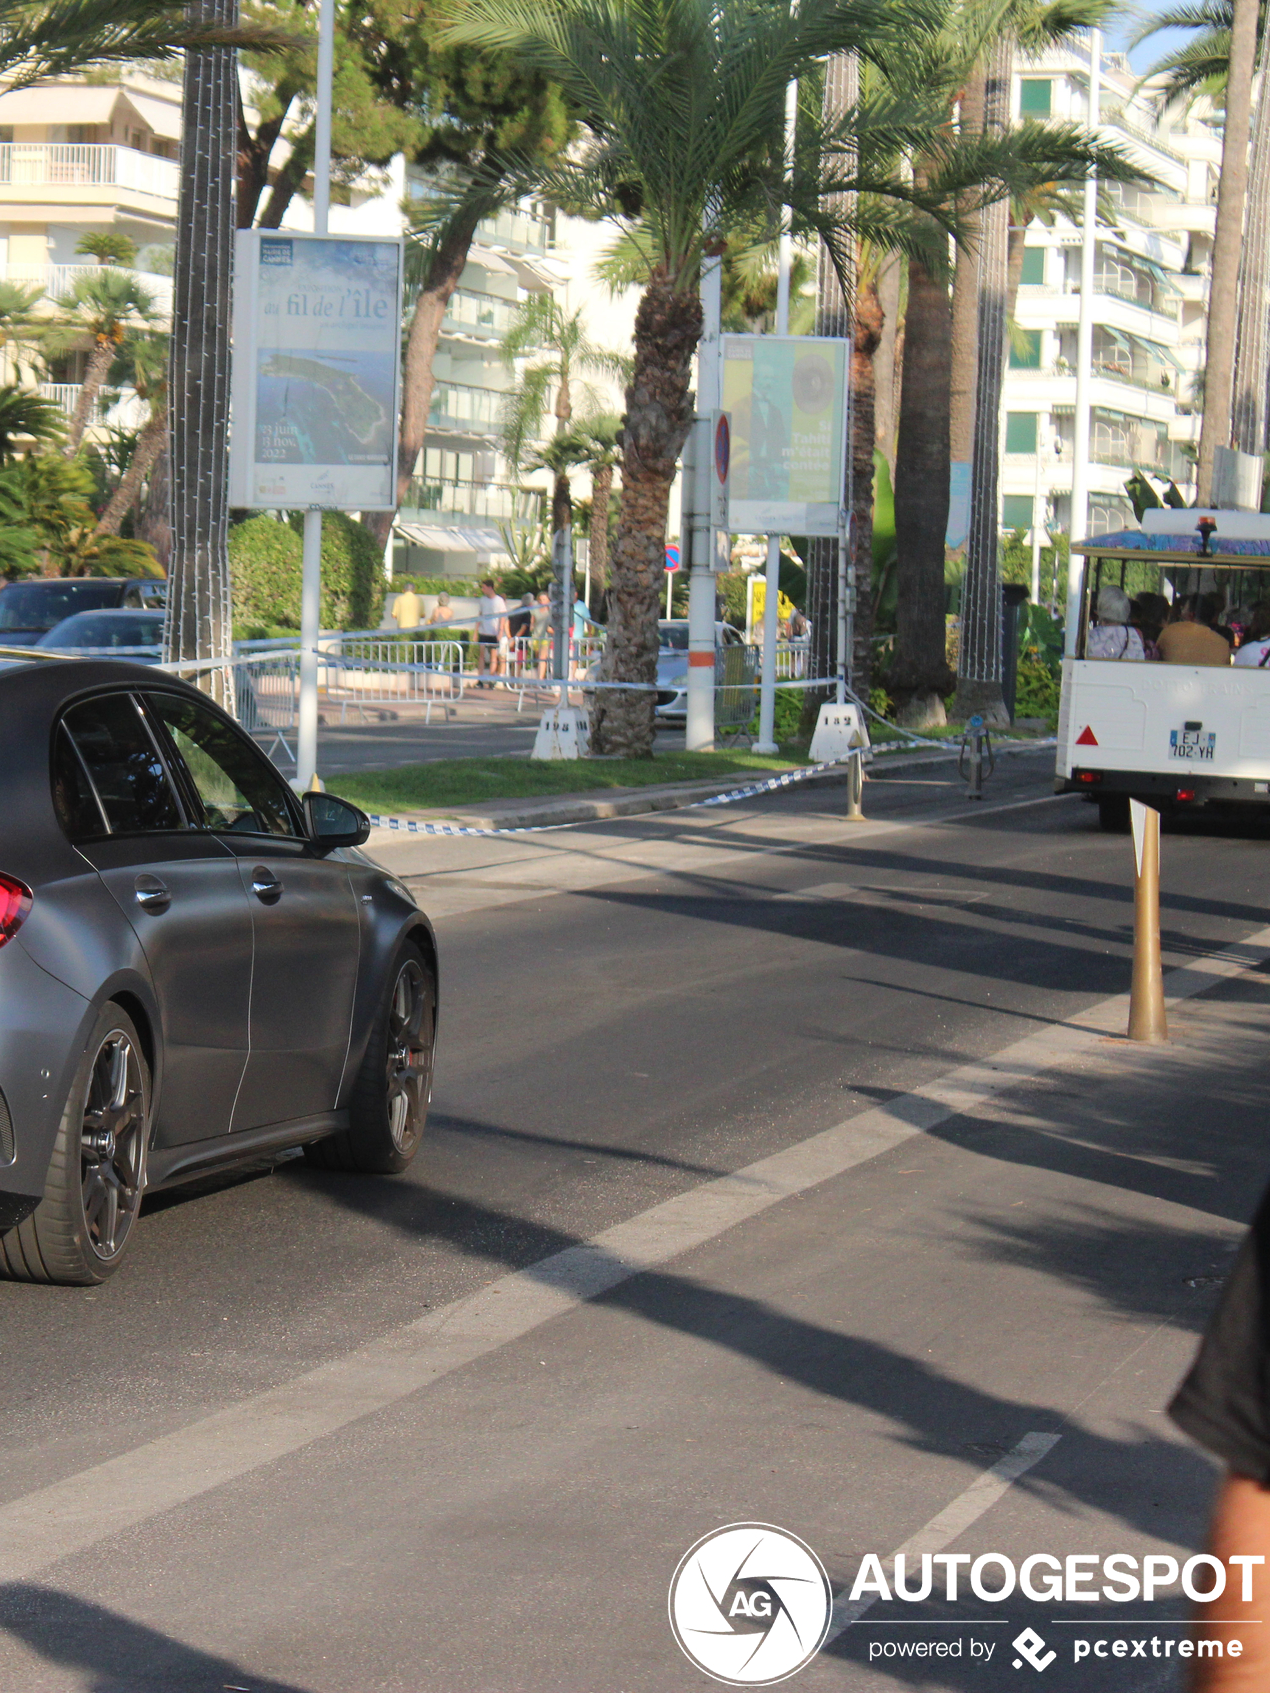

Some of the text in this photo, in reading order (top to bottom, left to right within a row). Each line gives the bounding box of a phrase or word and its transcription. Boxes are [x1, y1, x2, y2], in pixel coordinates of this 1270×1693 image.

[264, 302, 280, 315] au
[287, 294, 308, 316] fil
[313, 295, 333, 317] de
[274, 422, 298, 437] juin
[274, 437, 297, 447] nov.
[792, 432, 830, 445] Tahiti
[262, 448, 287, 459] 2022
